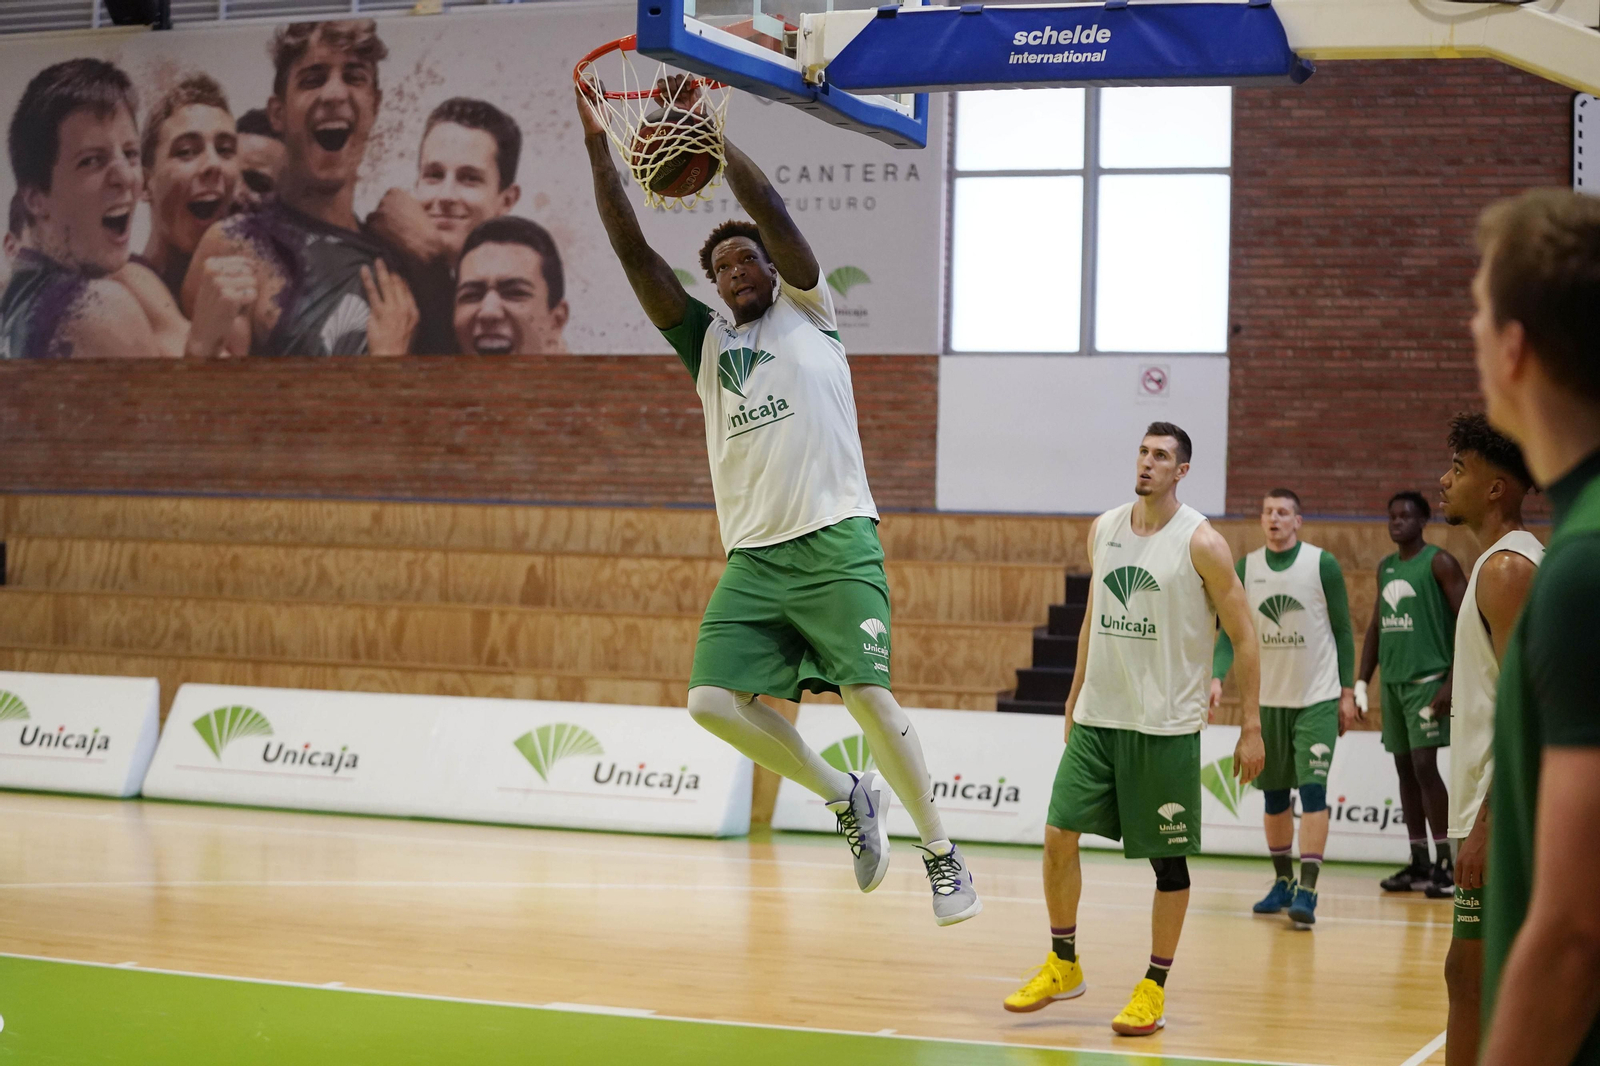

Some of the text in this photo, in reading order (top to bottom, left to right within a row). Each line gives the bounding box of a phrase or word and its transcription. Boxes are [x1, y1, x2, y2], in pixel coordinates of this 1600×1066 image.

[1012, 24, 1112, 46] schelde
[1008, 49, 1108, 64] international
[775, 162, 921, 185] CANTERA
[1101, 614, 1157, 637] Unicaja
[1262, 630, 1305, 646] Unicaja
[20, 724, 111, 755] Unicaja
[262, 741, 359, 774] Unicaja
[593, 761, 700, 795] Unicaja
[928, 773, 1021, 807] nicaja
[1159, 821, 1187, 832] Unicaja
